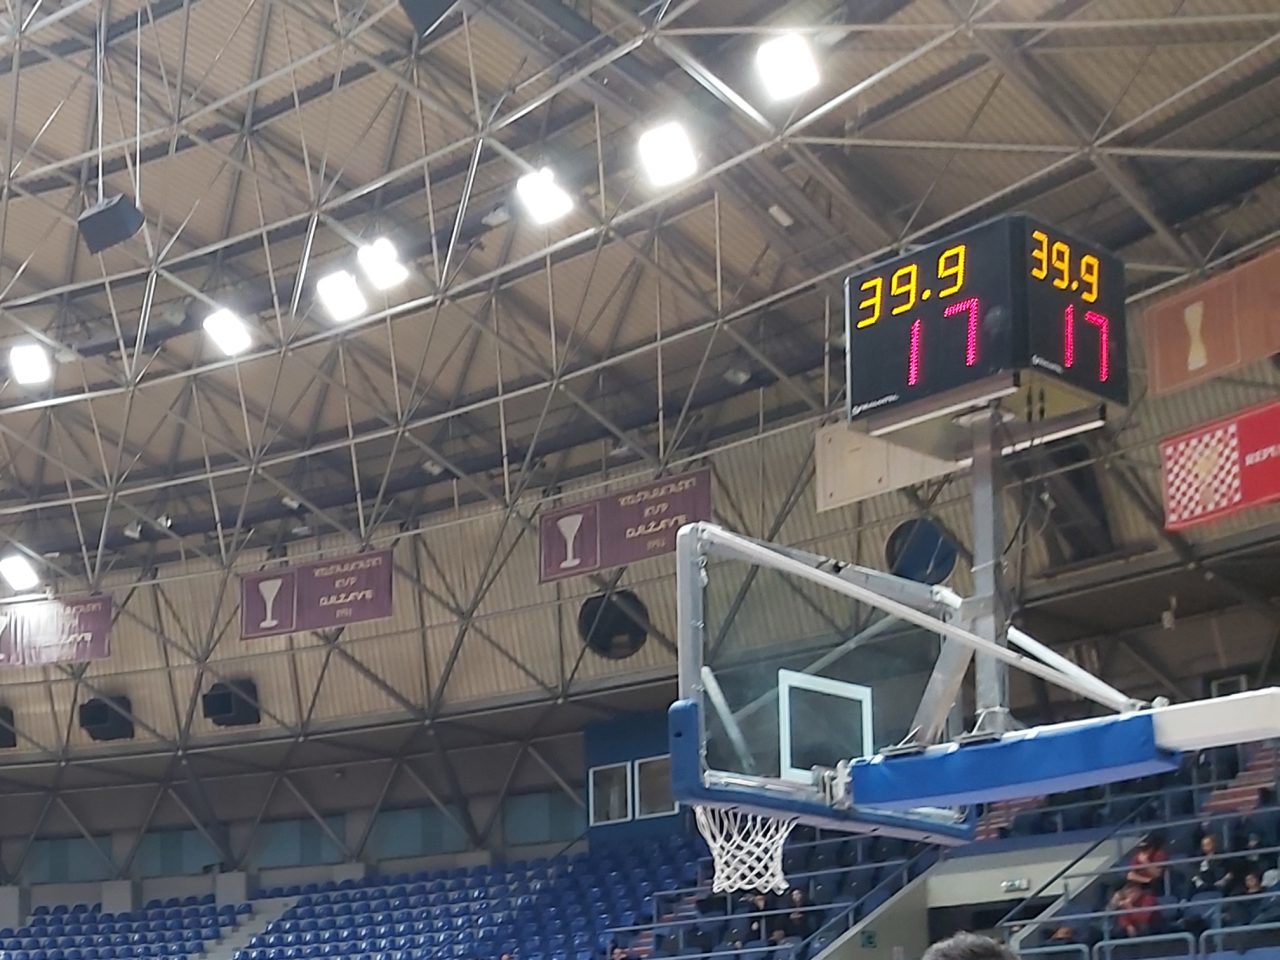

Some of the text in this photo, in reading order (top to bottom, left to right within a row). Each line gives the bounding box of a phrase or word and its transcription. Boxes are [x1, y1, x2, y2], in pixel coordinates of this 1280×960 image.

[857, 245, 966, 328] 39.9
[1031, 230, 1100, 304] 39.9
[907, 297, 979, 386] 17
[1064, 304, 1109, 383] 17
